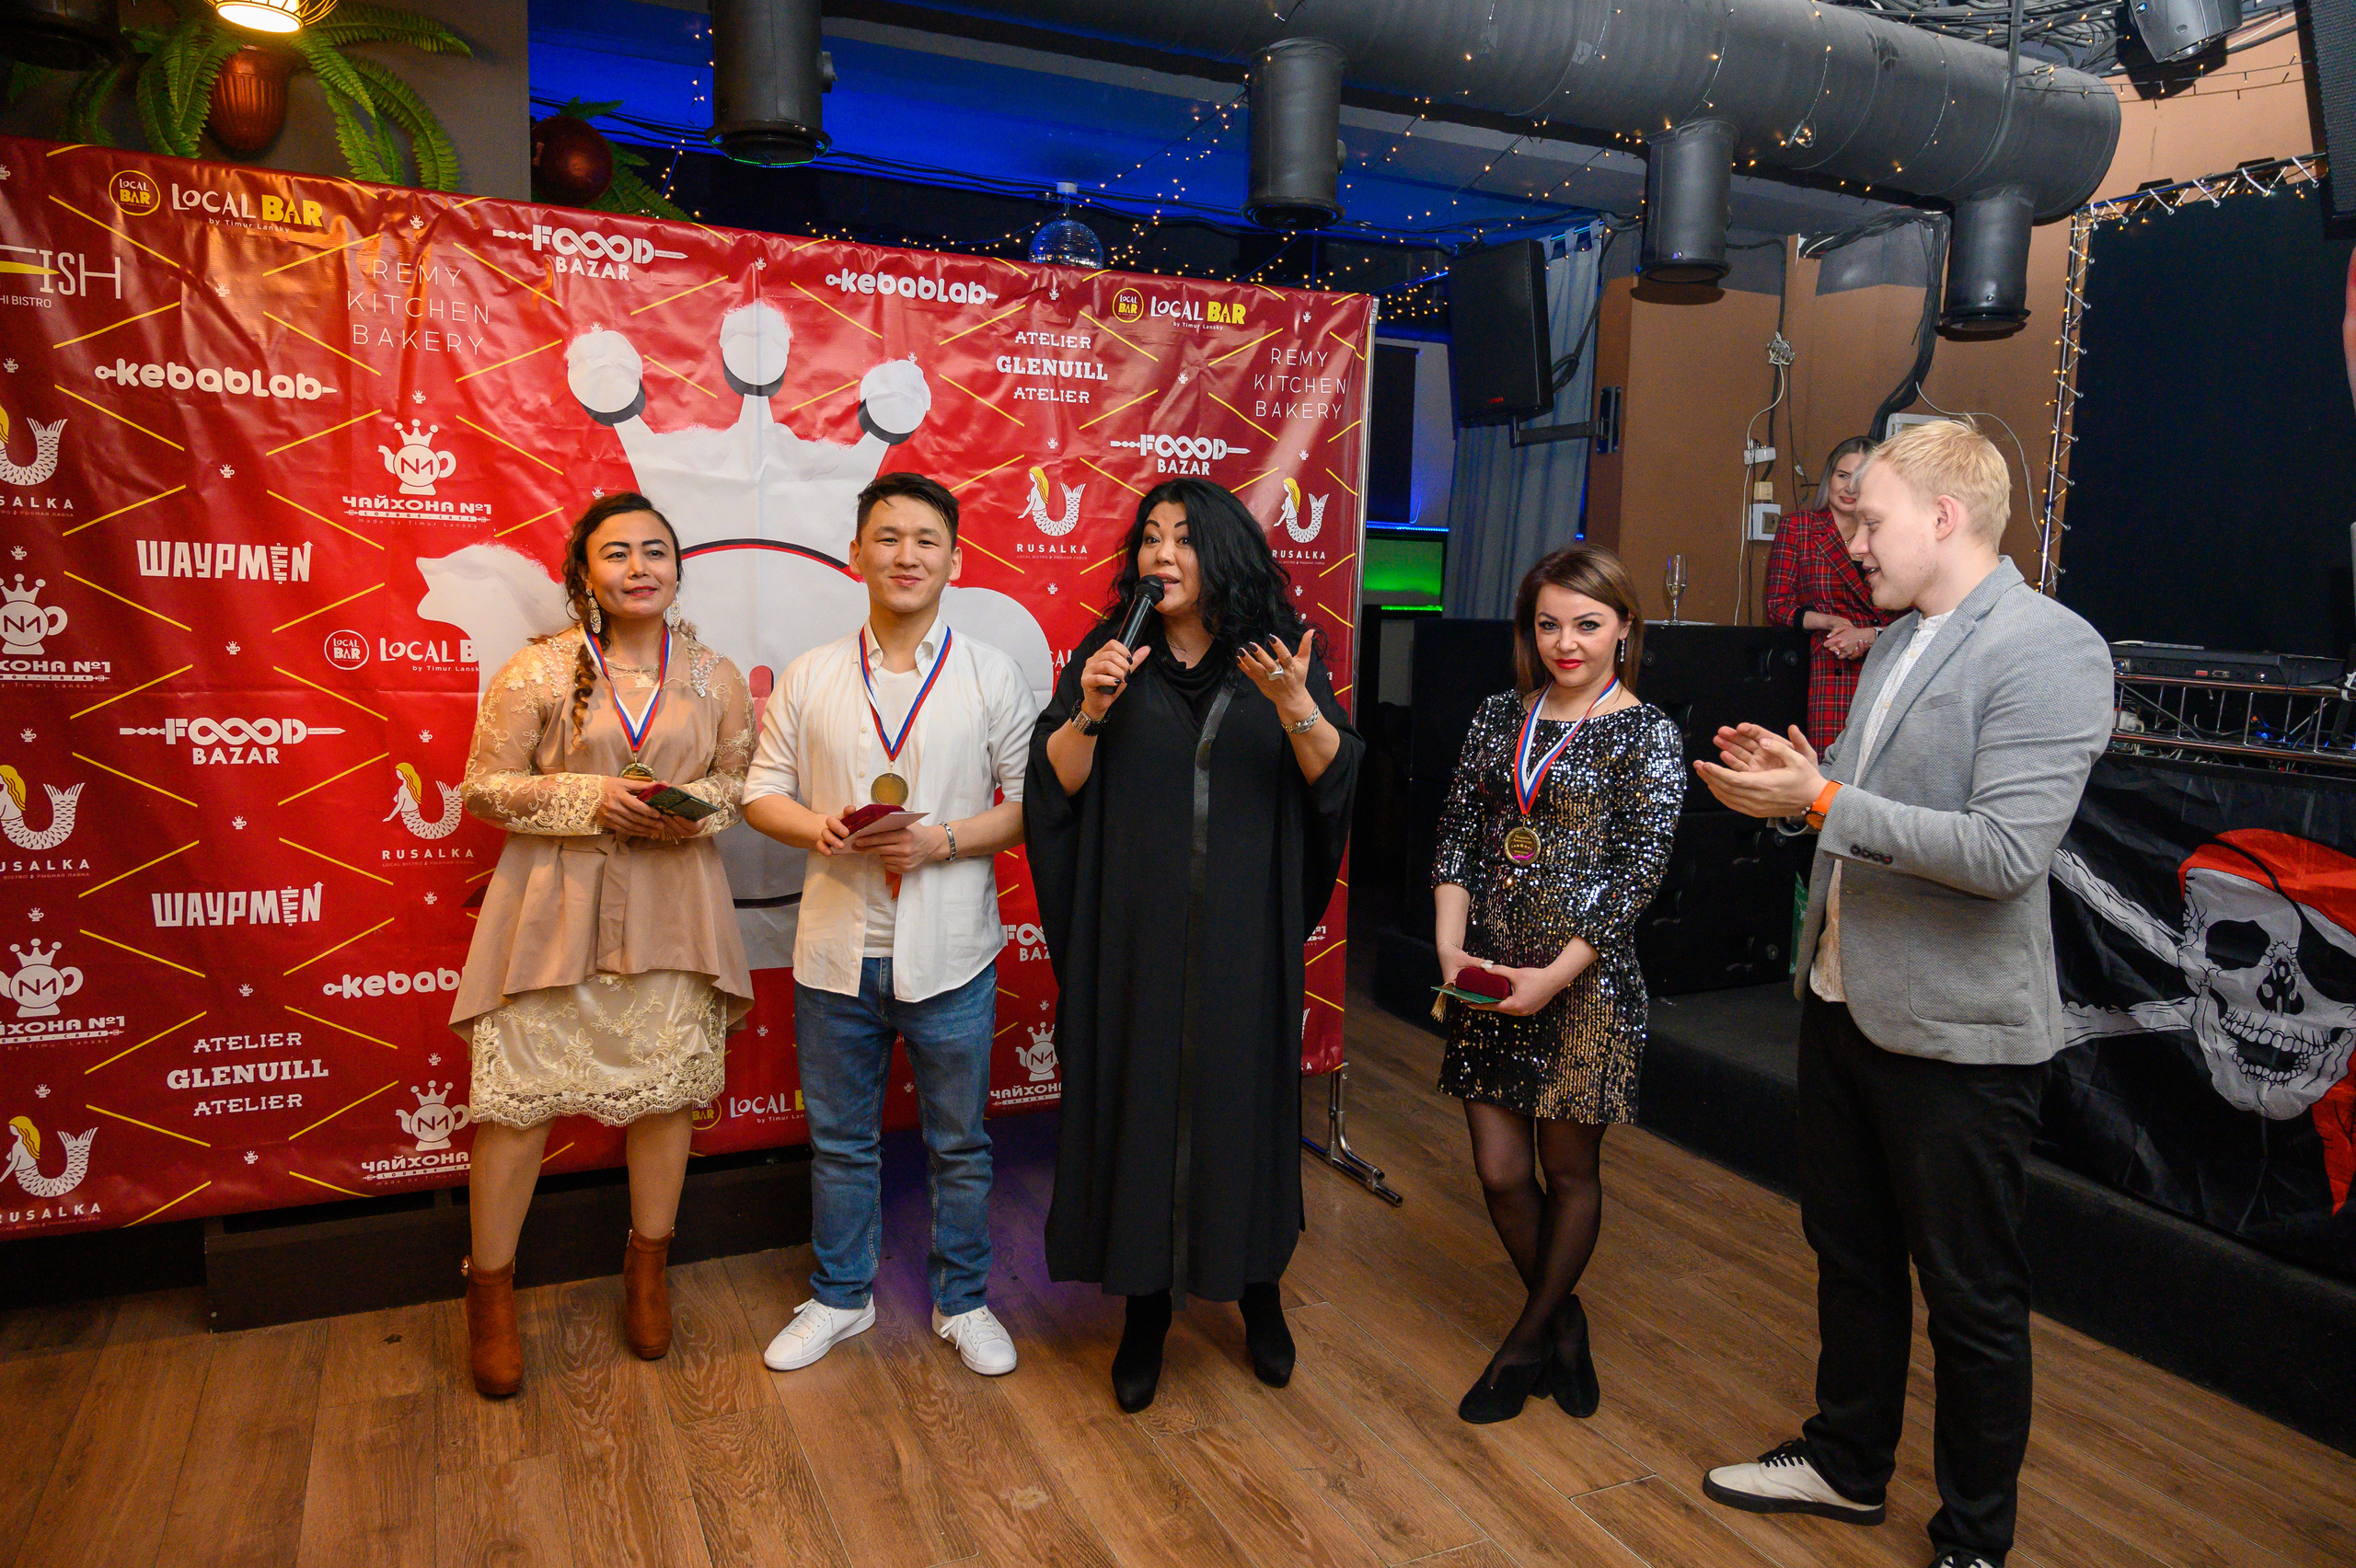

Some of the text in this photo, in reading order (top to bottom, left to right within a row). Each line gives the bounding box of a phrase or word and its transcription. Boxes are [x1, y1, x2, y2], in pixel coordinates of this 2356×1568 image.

[119, 178, 149, 191] LOCAL
[120, 190, 151, 205] BAR
[171, 183, 323, 227] LOCAL BAR
[209, 218, 290, 233] by Timur Lansky
[373, 259, 462, 287] REMY
[555, 256, 630, 281] BAZAR
[12, 295, 52, 308] BISTRO
[347, 290, 489, 325] KITCHEN
[1119, 294, 1138, 304] LOCAL
[1118, 303, 1138, 315] BAR
[1150, 295, 1247, 325] LOCAL BAR
[353, 324, 484, 355] BAKERY
[1014, 331, 1091, 349] ATELIER
[1270, 348, 1328, 367] REMY
[996, 355, 1108, 381] GLENUILL
[1253, 374, 1346, 395] KITCHEN
[1013, 386, 1090, 404] ATELIER
[1255, 400, 1342, 420] BAKERY
[1157, 458, 1210, 476] BAZAR
[342, 494, 455, 513] ЧАЙХОНА
[1016, 543, 1088, 554] RUSALKA
[1272, 549, 1325, 559] RUSALKA
[333, 638, 360, 648] LOCAL
[380, 638, 455, 663] LOCAL
[333, 648, 361, 660] BAR
[192, 747, 280, 765] BAZAR
[382, 848, 474, 860] RUSALKA
[193, 1032, 302, 1054] ATELIER
[167, 1059, 329, 1090] GLENUILL
[989, 1082, 1061, 1100] ЧАЙХОН
[193, 1093, 303, 1117] ATELIER
[730, 1093, 791, 1118] LOCAL
[361, 1152, 469, 1172] ЧАЙХОНА
